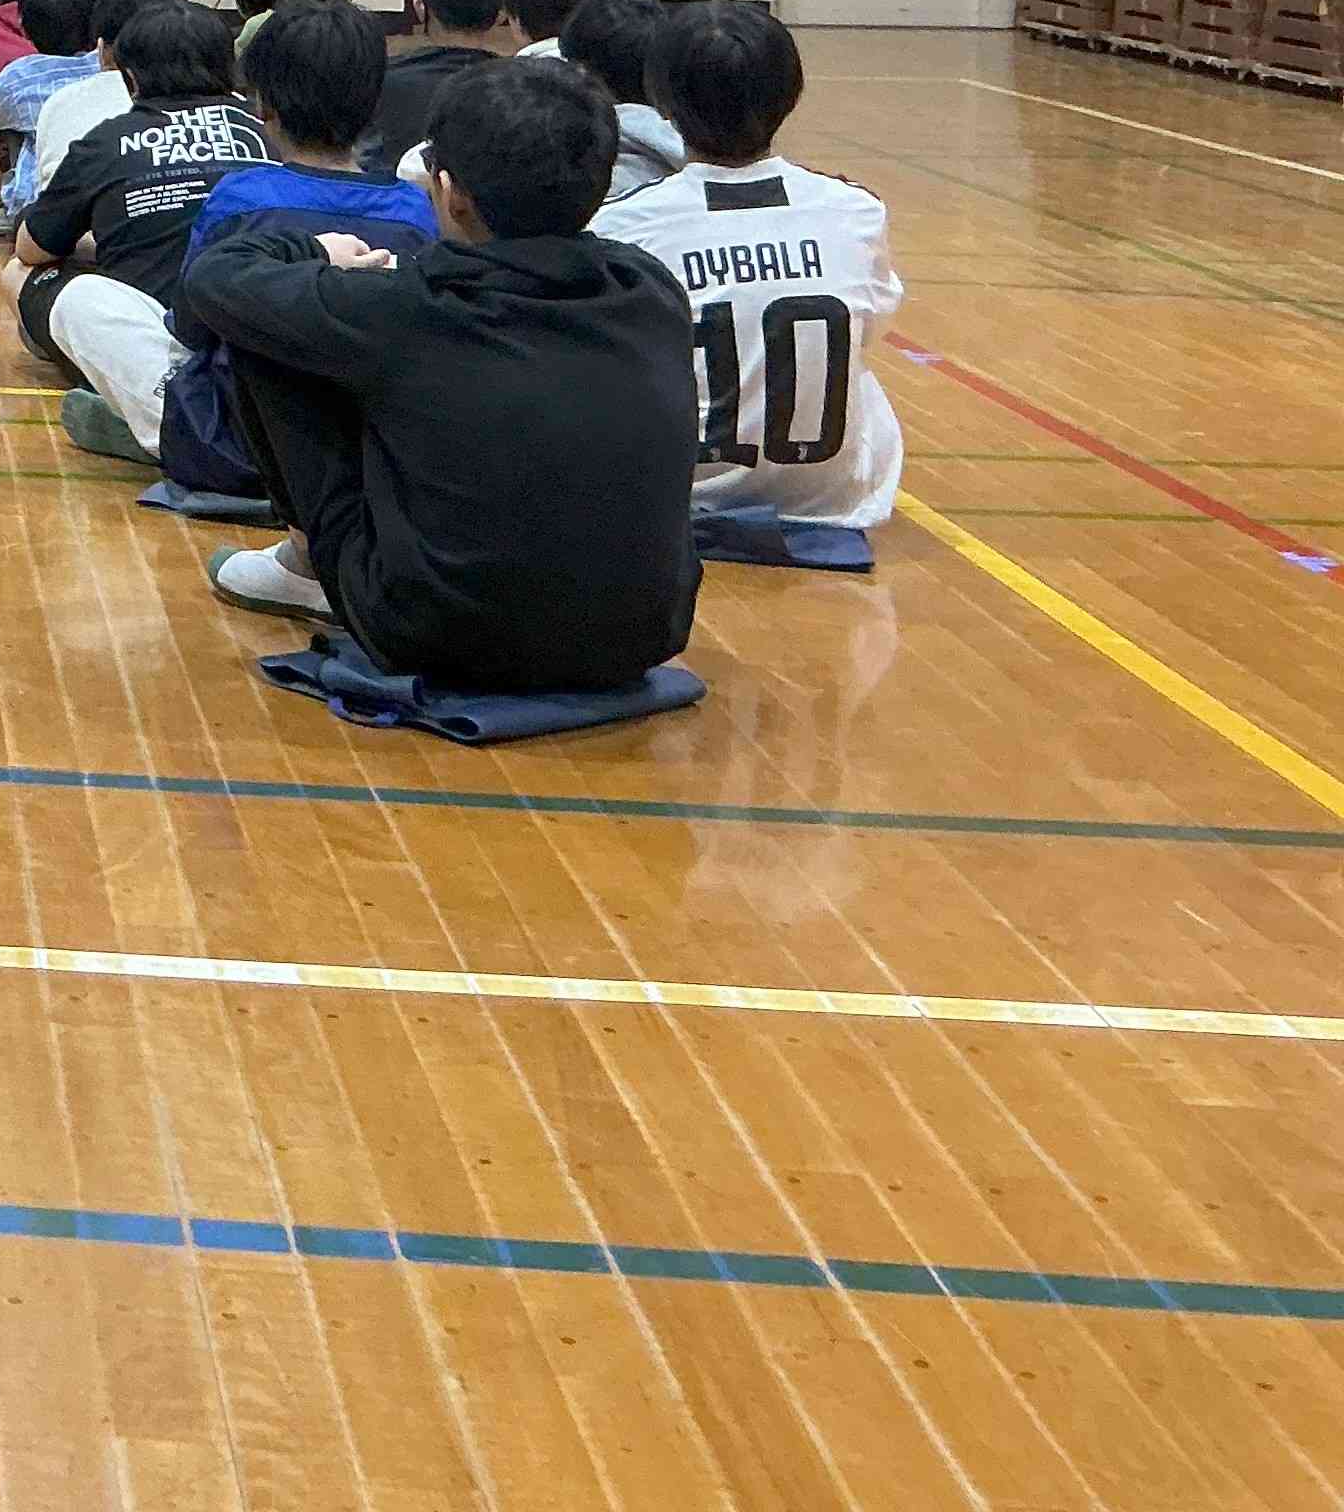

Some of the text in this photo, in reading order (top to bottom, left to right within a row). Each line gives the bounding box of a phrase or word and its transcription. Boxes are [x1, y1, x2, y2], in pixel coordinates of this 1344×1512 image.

[162, 104, 224, 126] THE
[119, 124, 231, 156] NORTH
[151, 141, 234, 167] FACE
[683, 239, 823, 291] DYBALA
[694, 294, 852, 469] 10
